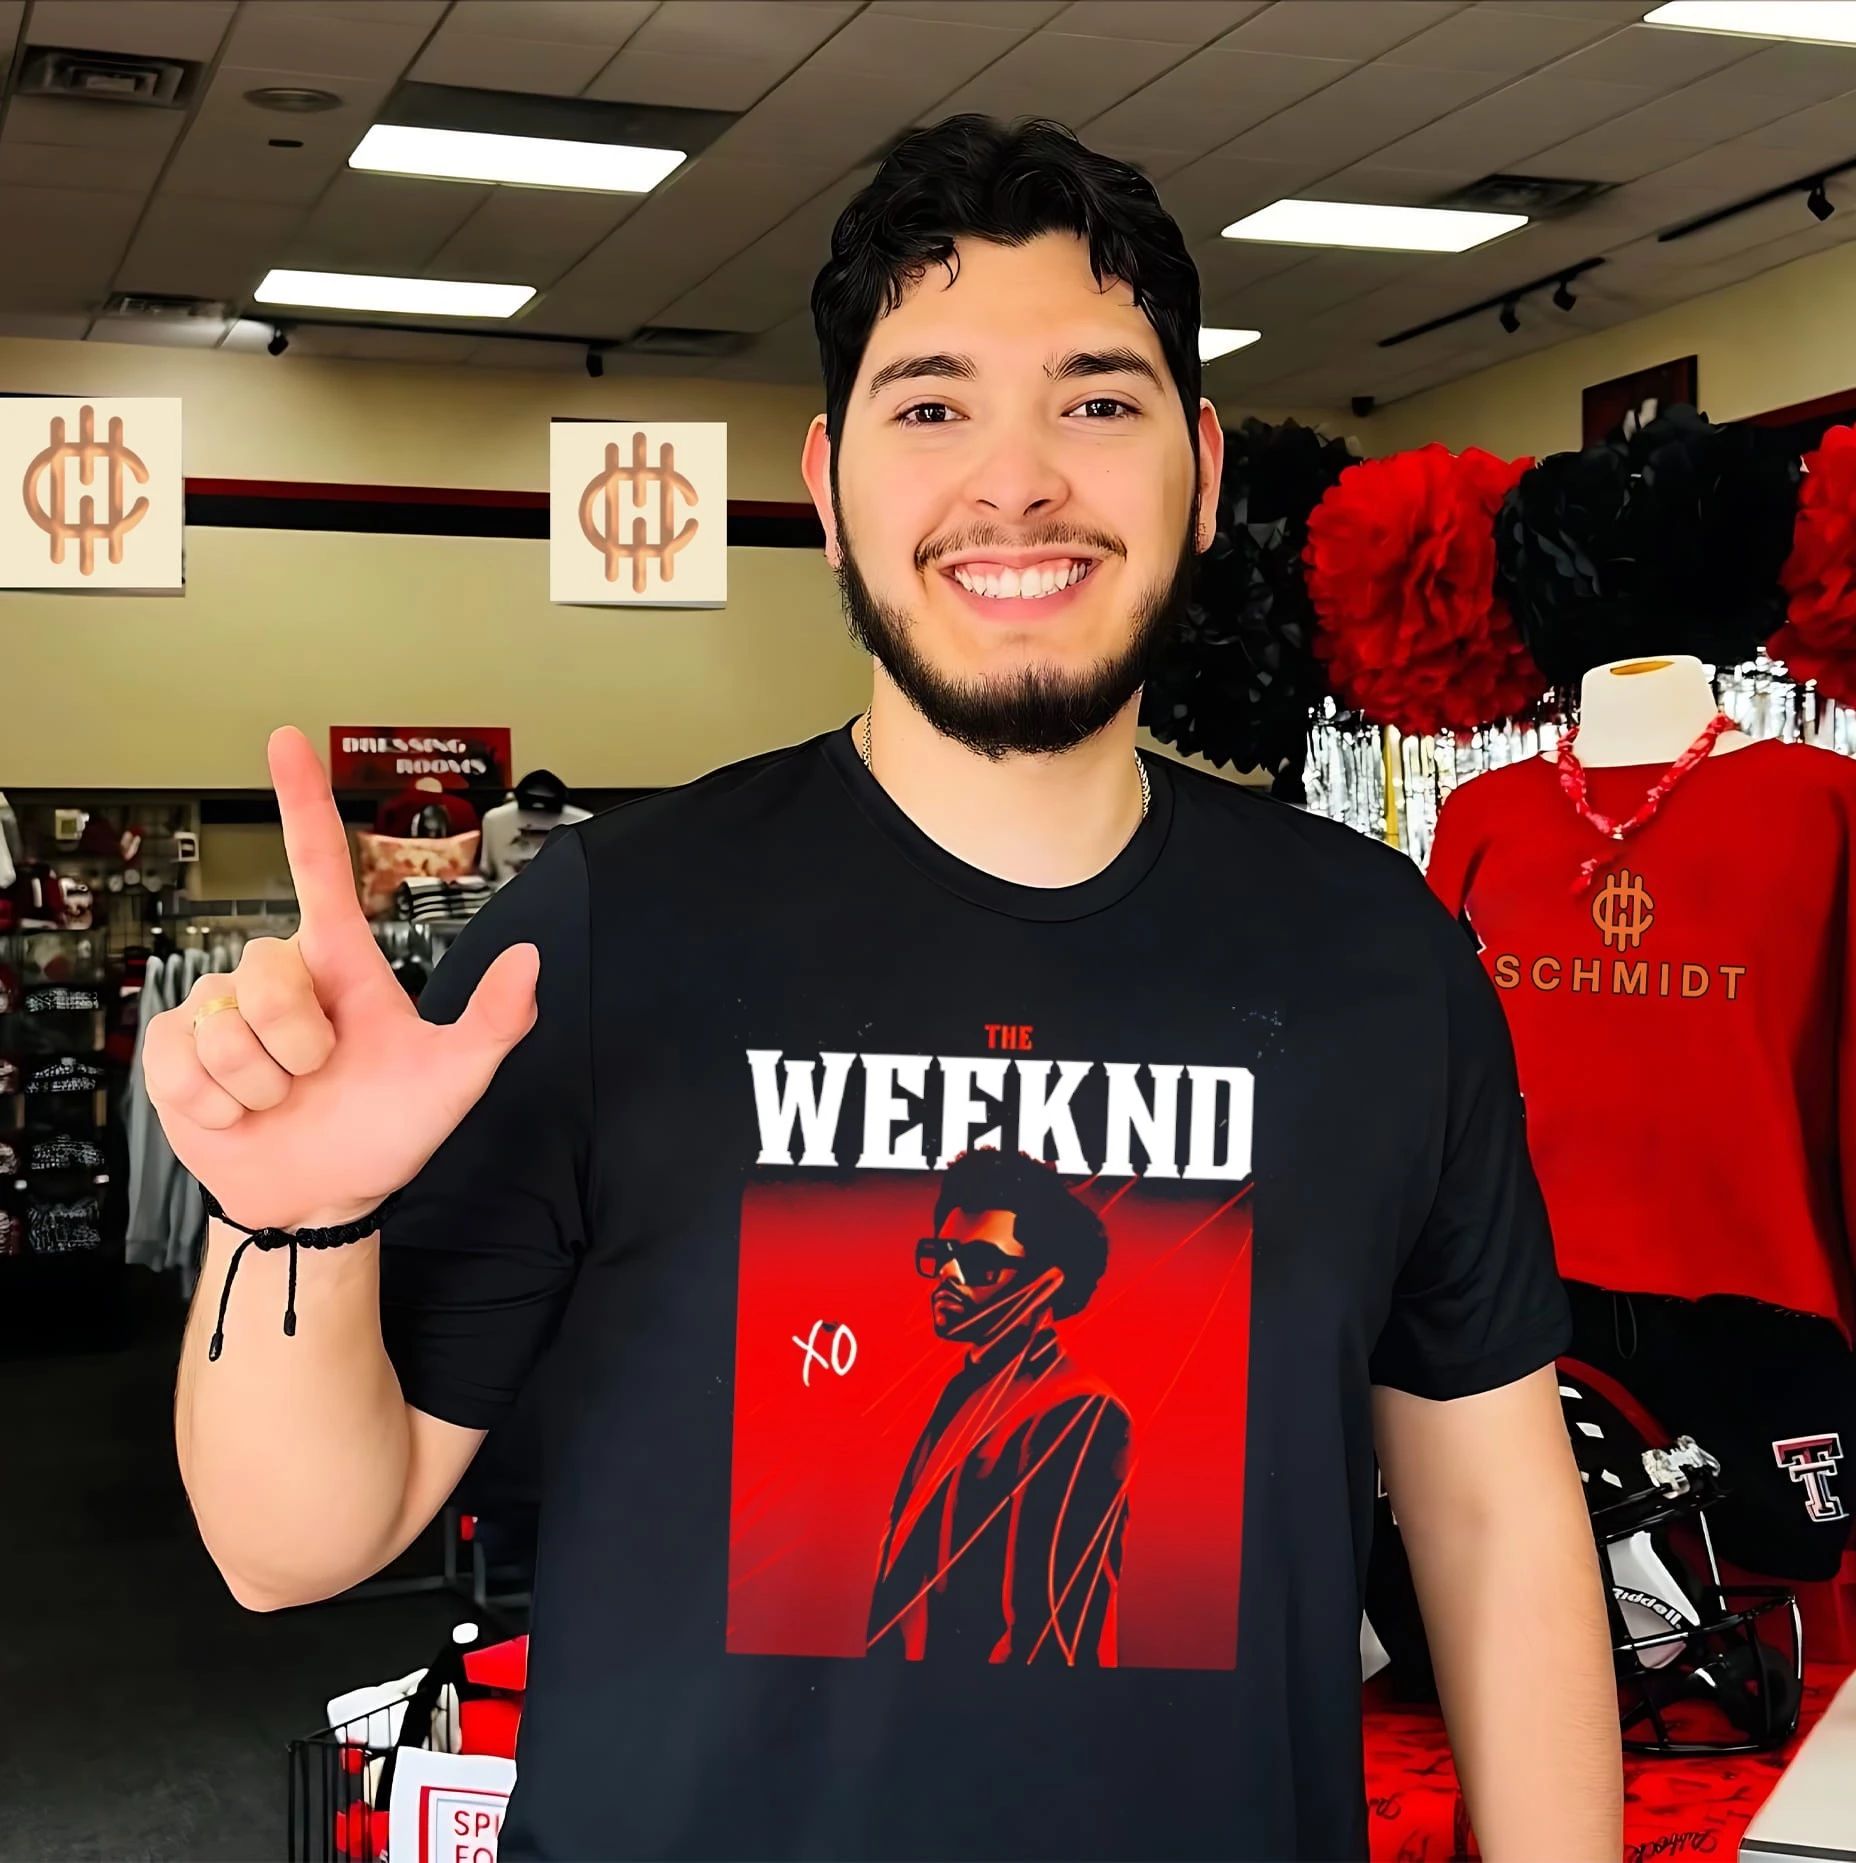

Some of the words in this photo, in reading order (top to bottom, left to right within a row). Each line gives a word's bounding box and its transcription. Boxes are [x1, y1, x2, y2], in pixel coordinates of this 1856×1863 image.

[1494, 954, 1746, 1000] SCHMIDT
[984, 1023, 1034, 1051] THE
[746, 1049, 1256, 1181] WEEKND
[792, 1319, 858, 1388] XO
